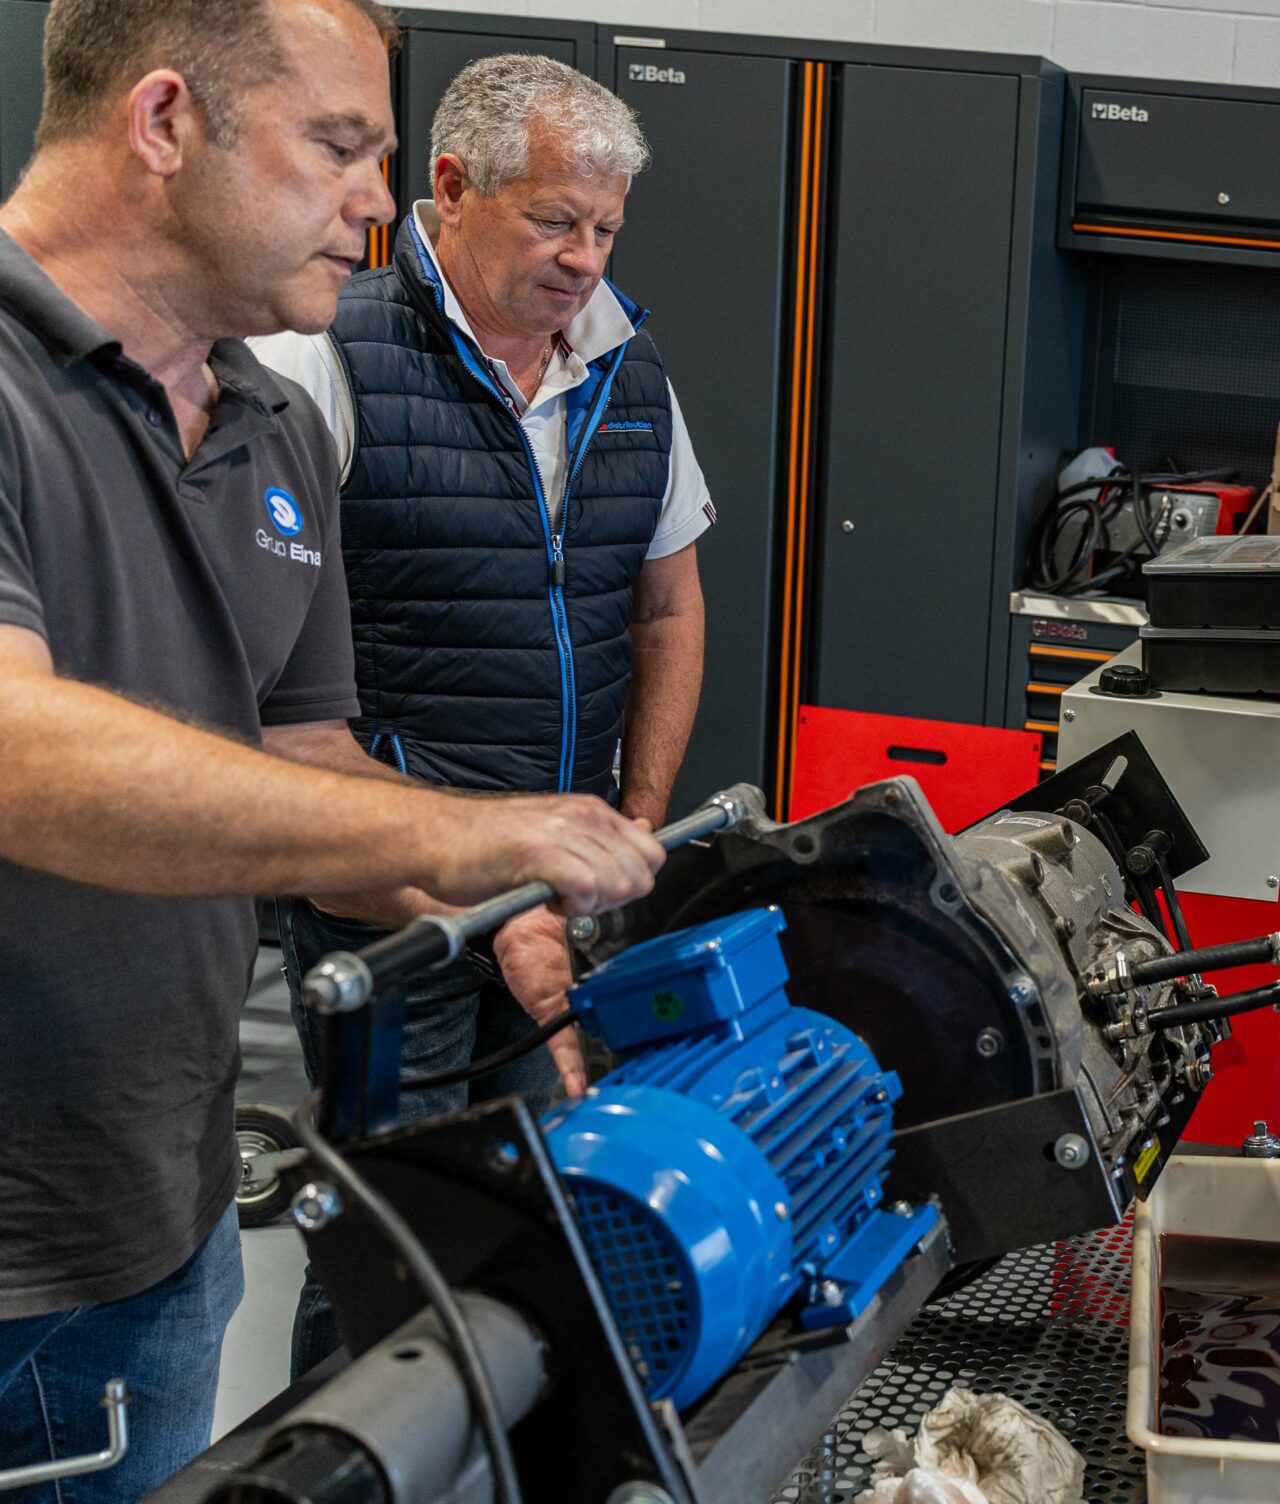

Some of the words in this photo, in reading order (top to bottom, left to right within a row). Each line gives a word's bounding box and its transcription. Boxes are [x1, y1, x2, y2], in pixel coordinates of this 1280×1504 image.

[644, 64, 686, 84] Beta
[1107, 104, 1149, 122] Beta
[290, 542, 321, 567] Eina
